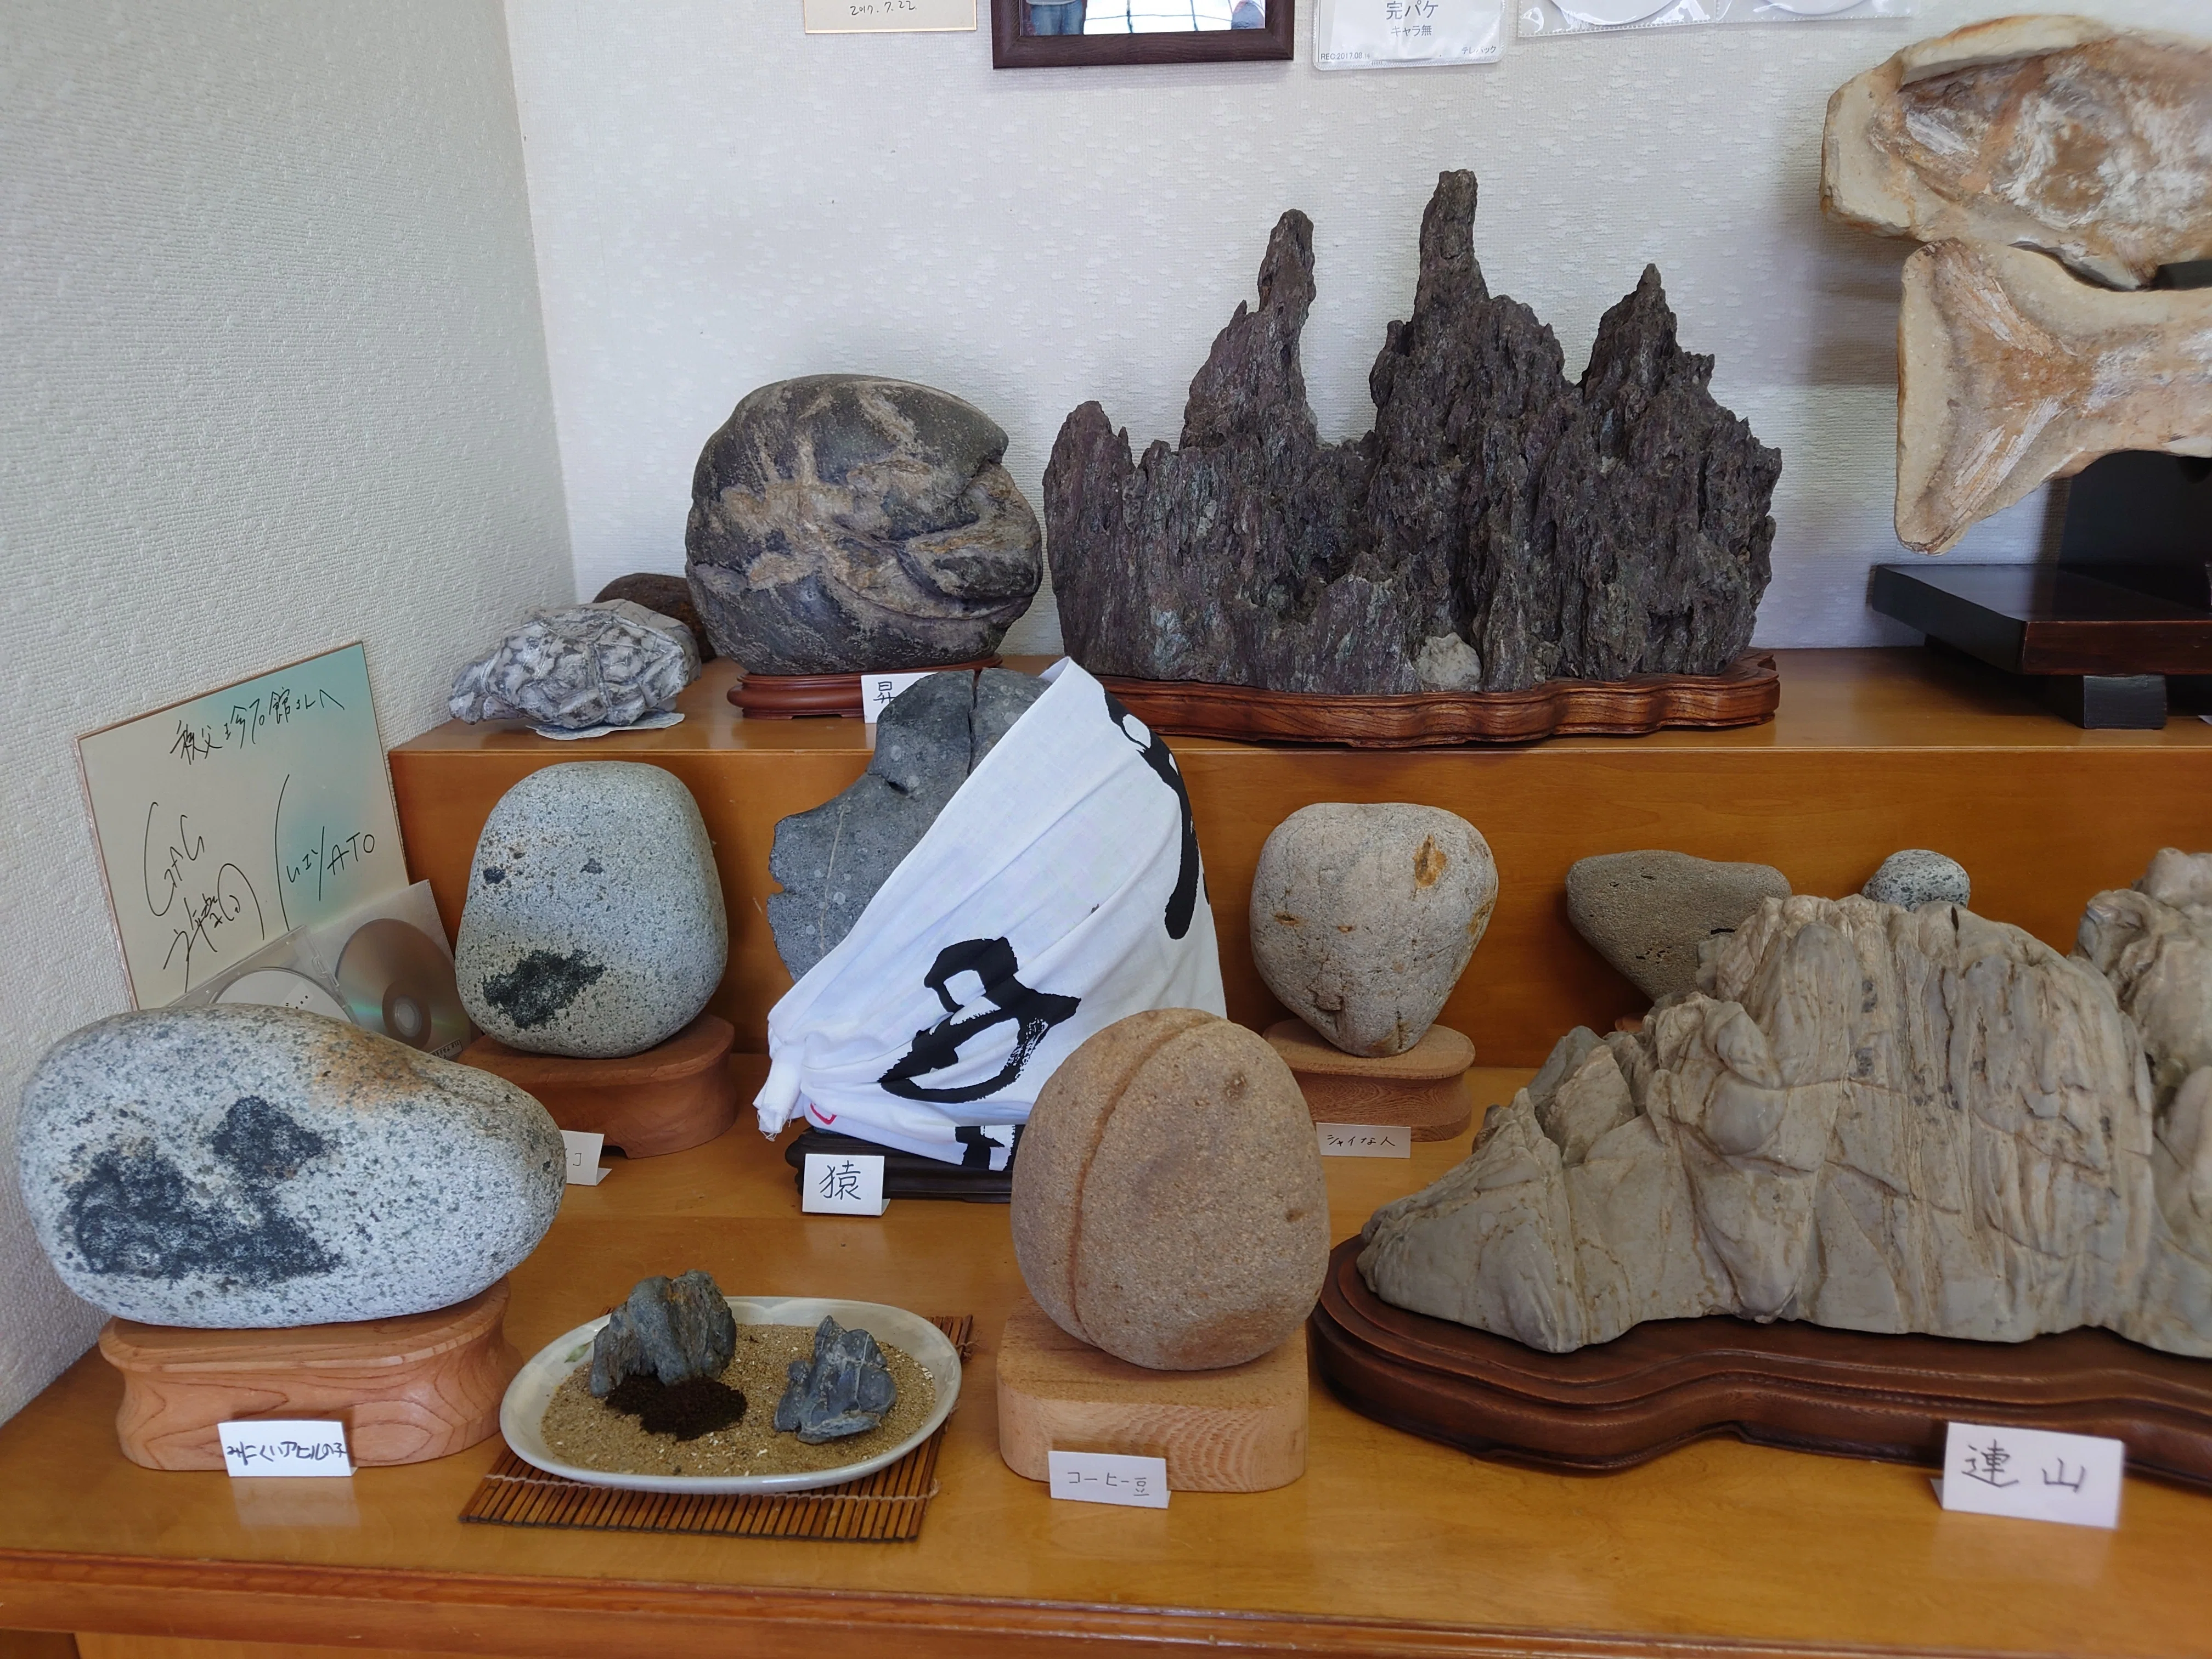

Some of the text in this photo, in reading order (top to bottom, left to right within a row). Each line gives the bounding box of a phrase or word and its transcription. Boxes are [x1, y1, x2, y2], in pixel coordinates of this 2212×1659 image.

[1386, 0, 1439, 20] 完パケ
[1391, 25, 1432, 38] キャラ無
[1327, 1135, 1396, 1147] シャイな人
[819, 1160, 861, 1200] 猿
[227, 1441, 347, 1466] みにくいアヒルの子
[1067, 1471, 1149, 1497] コーヒー豆
